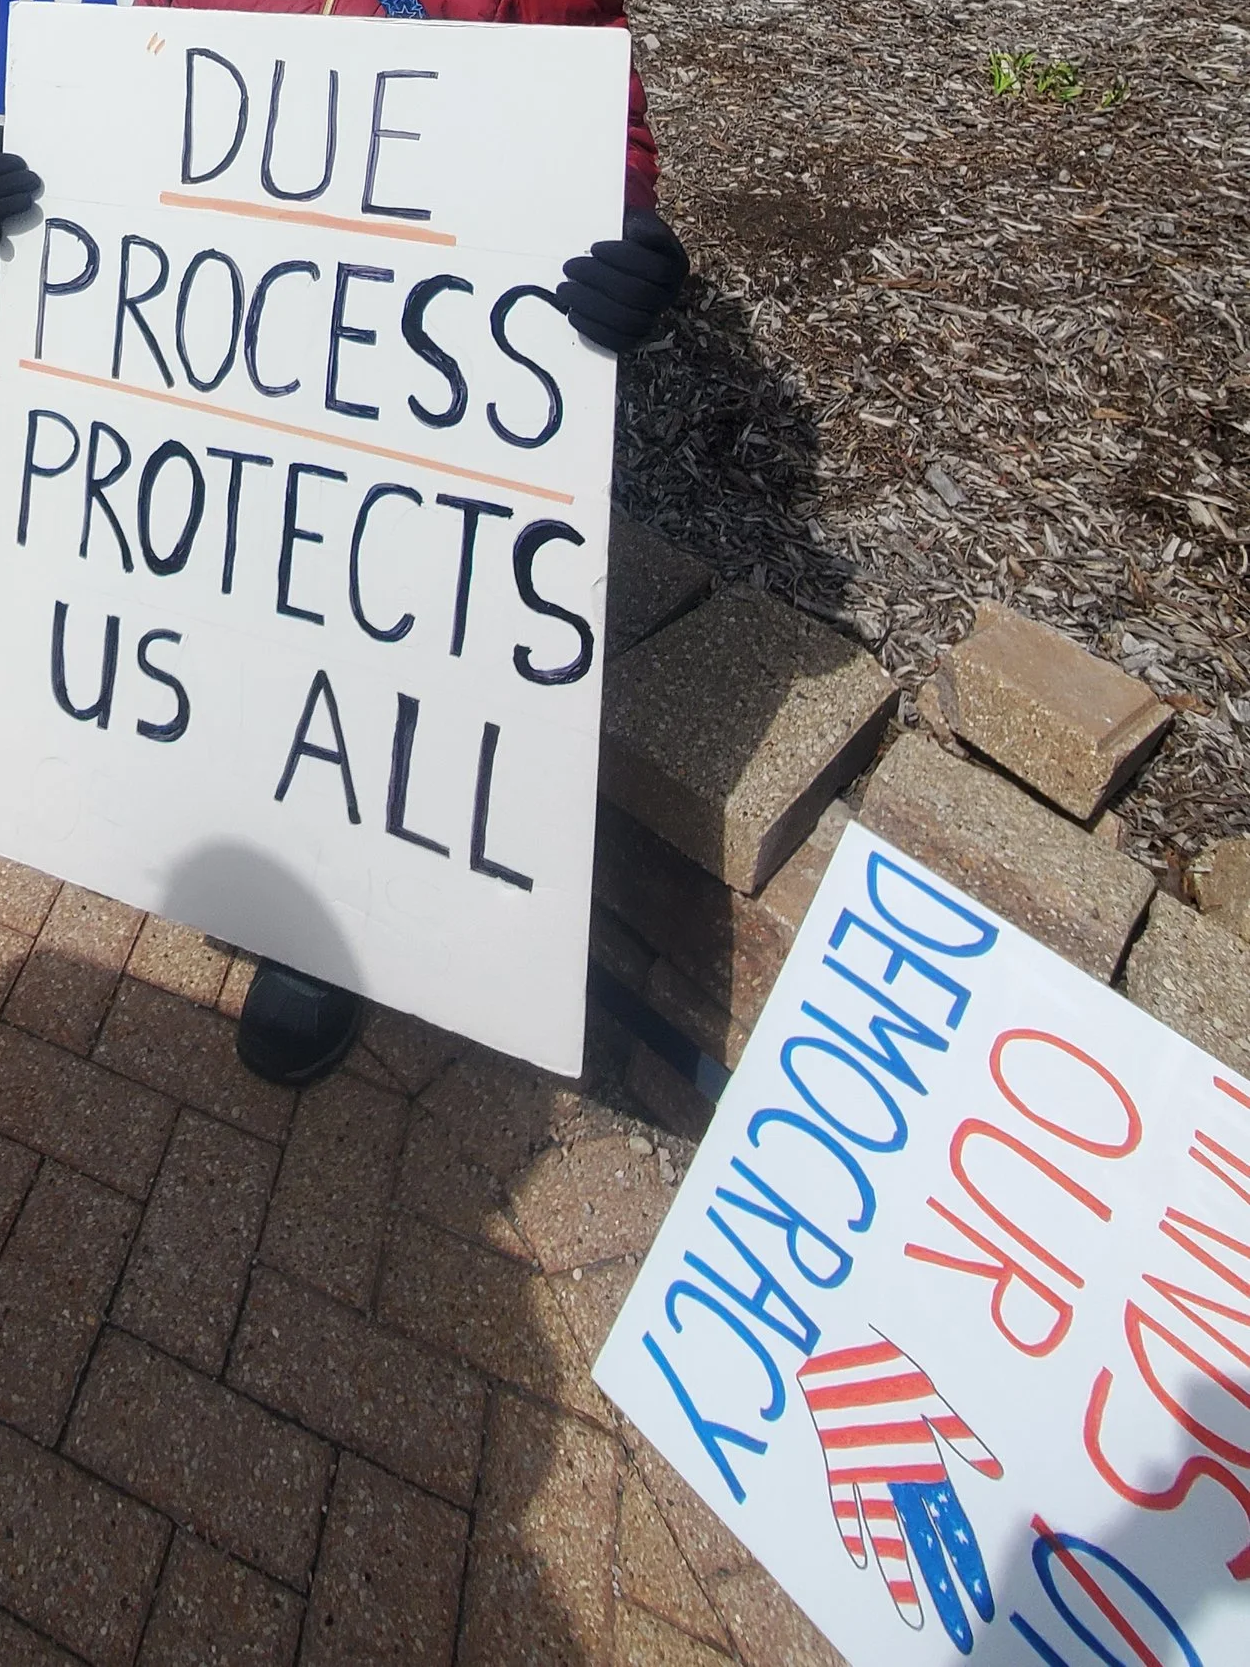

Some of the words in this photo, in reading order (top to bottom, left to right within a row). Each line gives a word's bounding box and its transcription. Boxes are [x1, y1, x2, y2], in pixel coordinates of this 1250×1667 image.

[35, 218, 572, 450] PROCESS
[17, 409, 595, 687] PROTECTS
[50, 599, 191, 744] US
[273, 668, 534, 893] ALL
[643, 851, 1000, 1506] DEMOCRACY
[904, 1028, 1143, 1358] OUR
